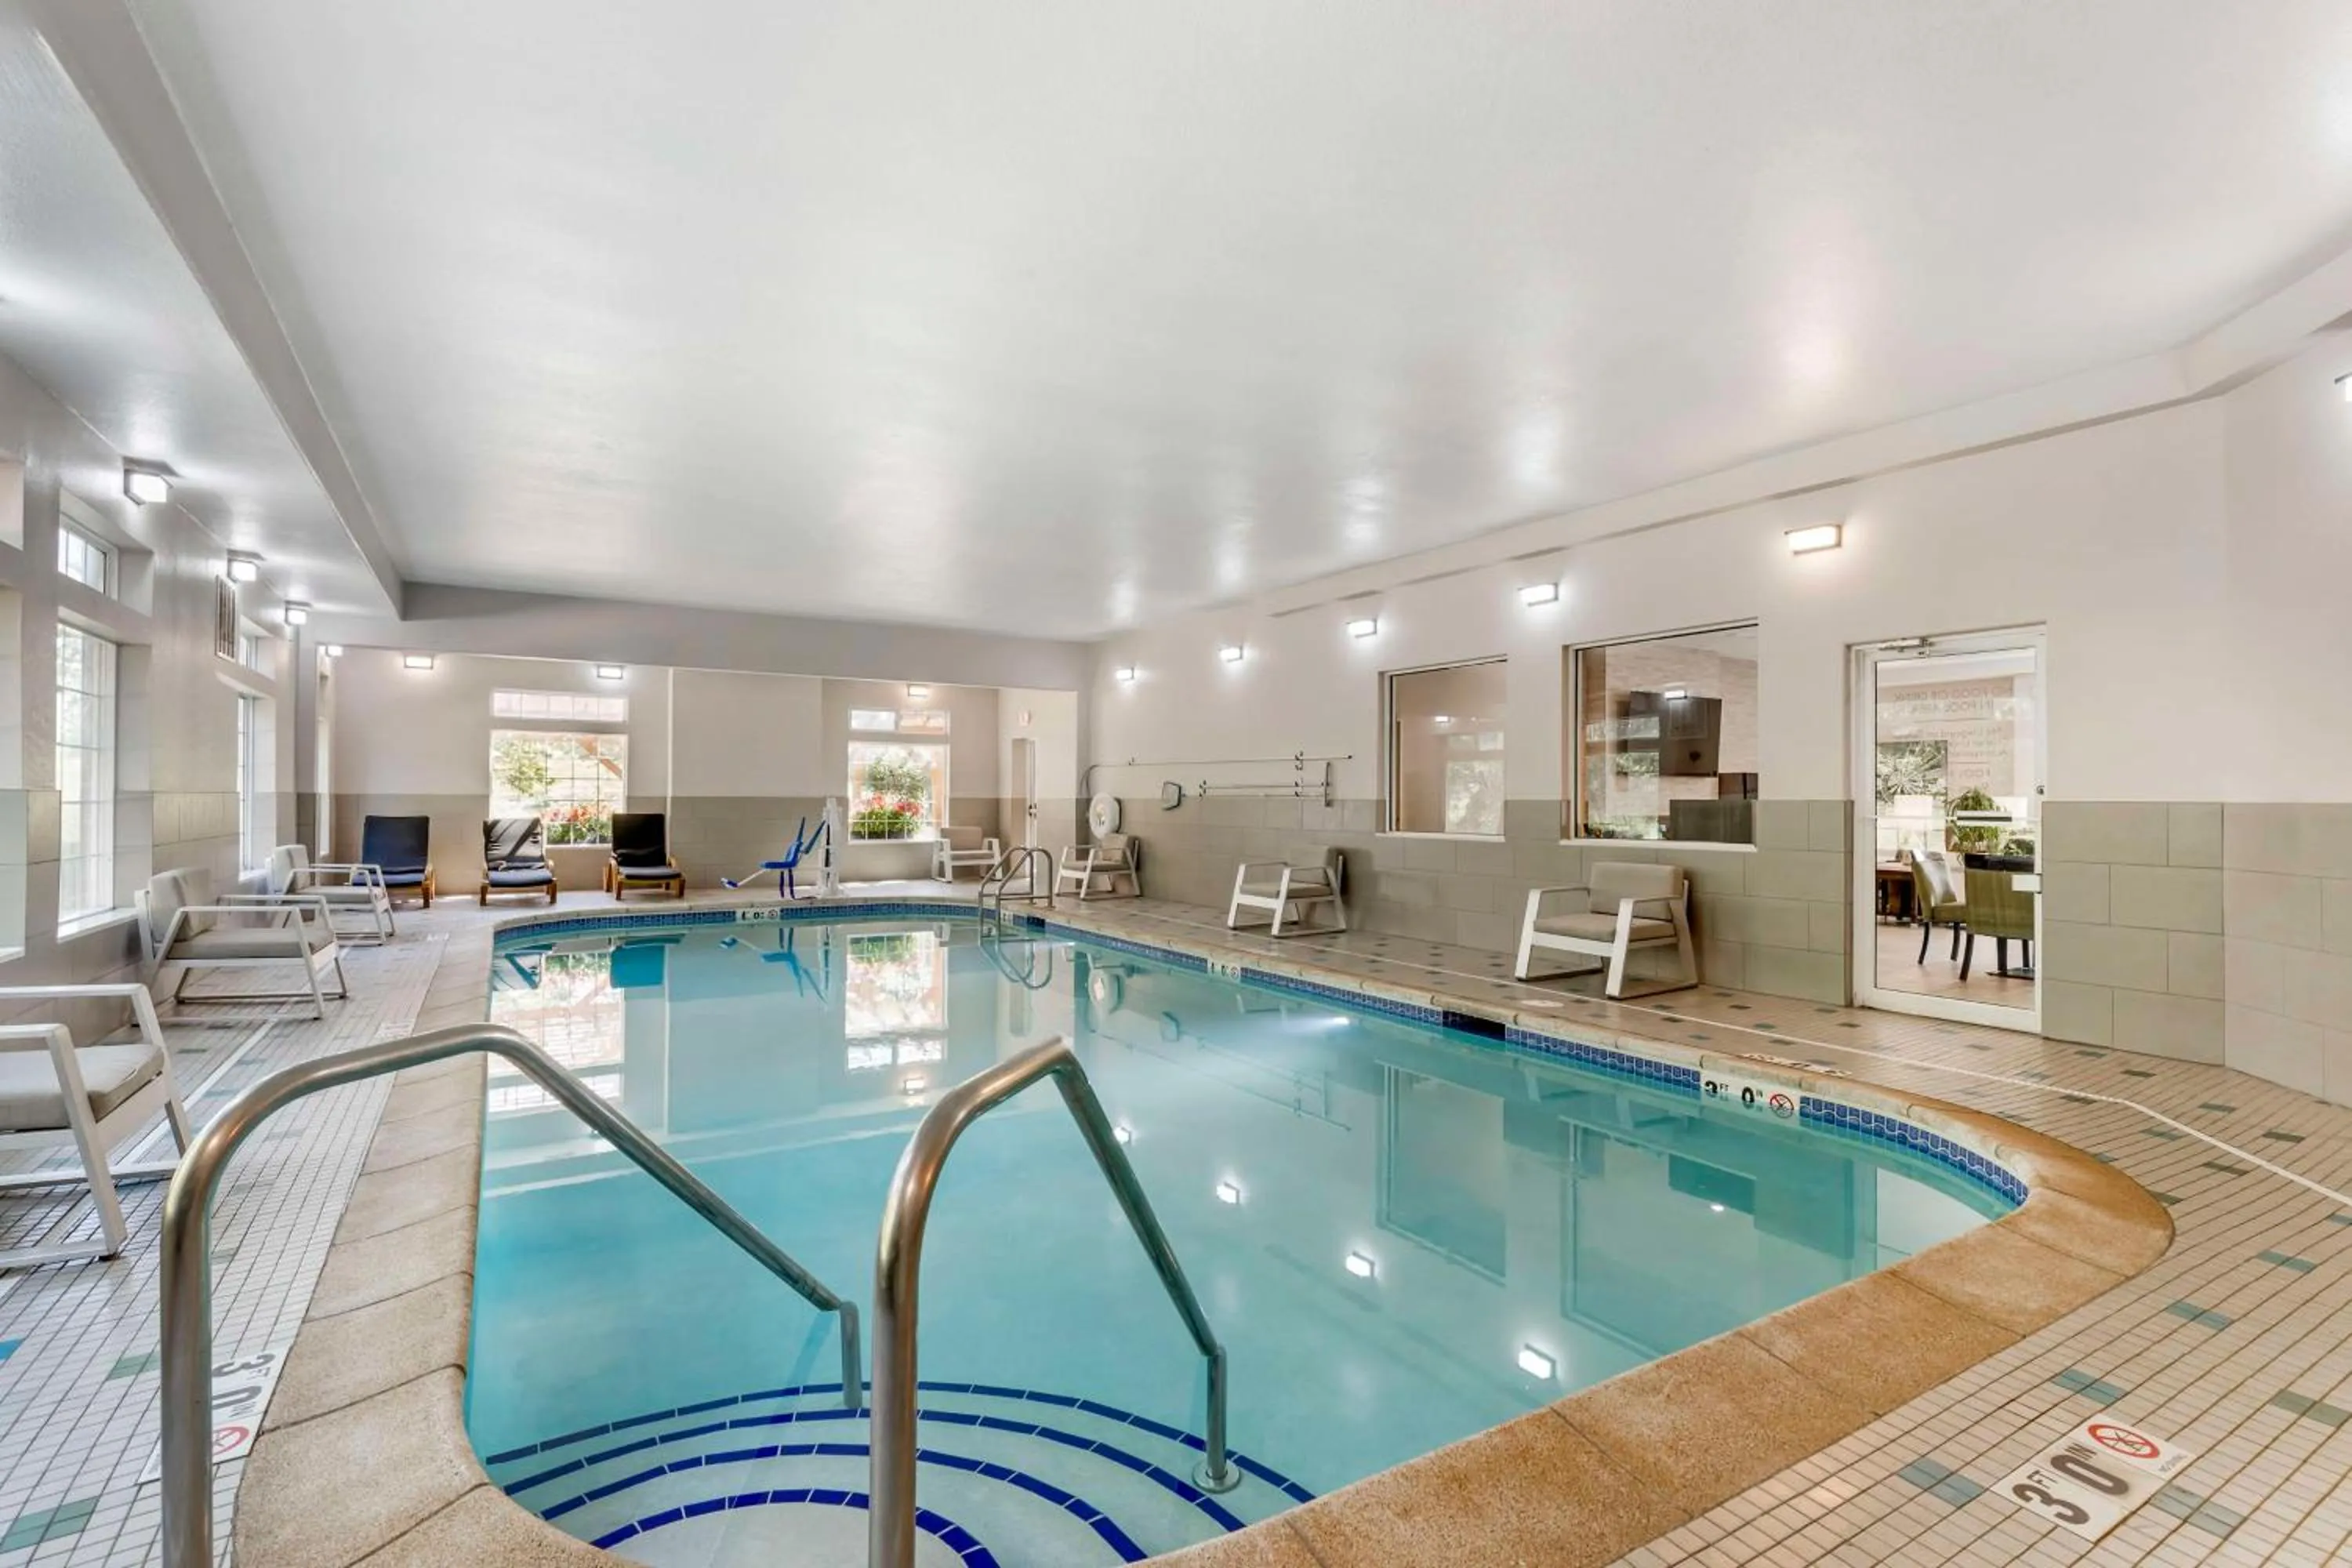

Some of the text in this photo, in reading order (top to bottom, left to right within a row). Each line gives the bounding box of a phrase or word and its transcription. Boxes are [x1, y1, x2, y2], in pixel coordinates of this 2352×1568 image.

[2012, 1469, 2090, 1525] 3 FT
[2050, 1454, 2129, 1496] 0
